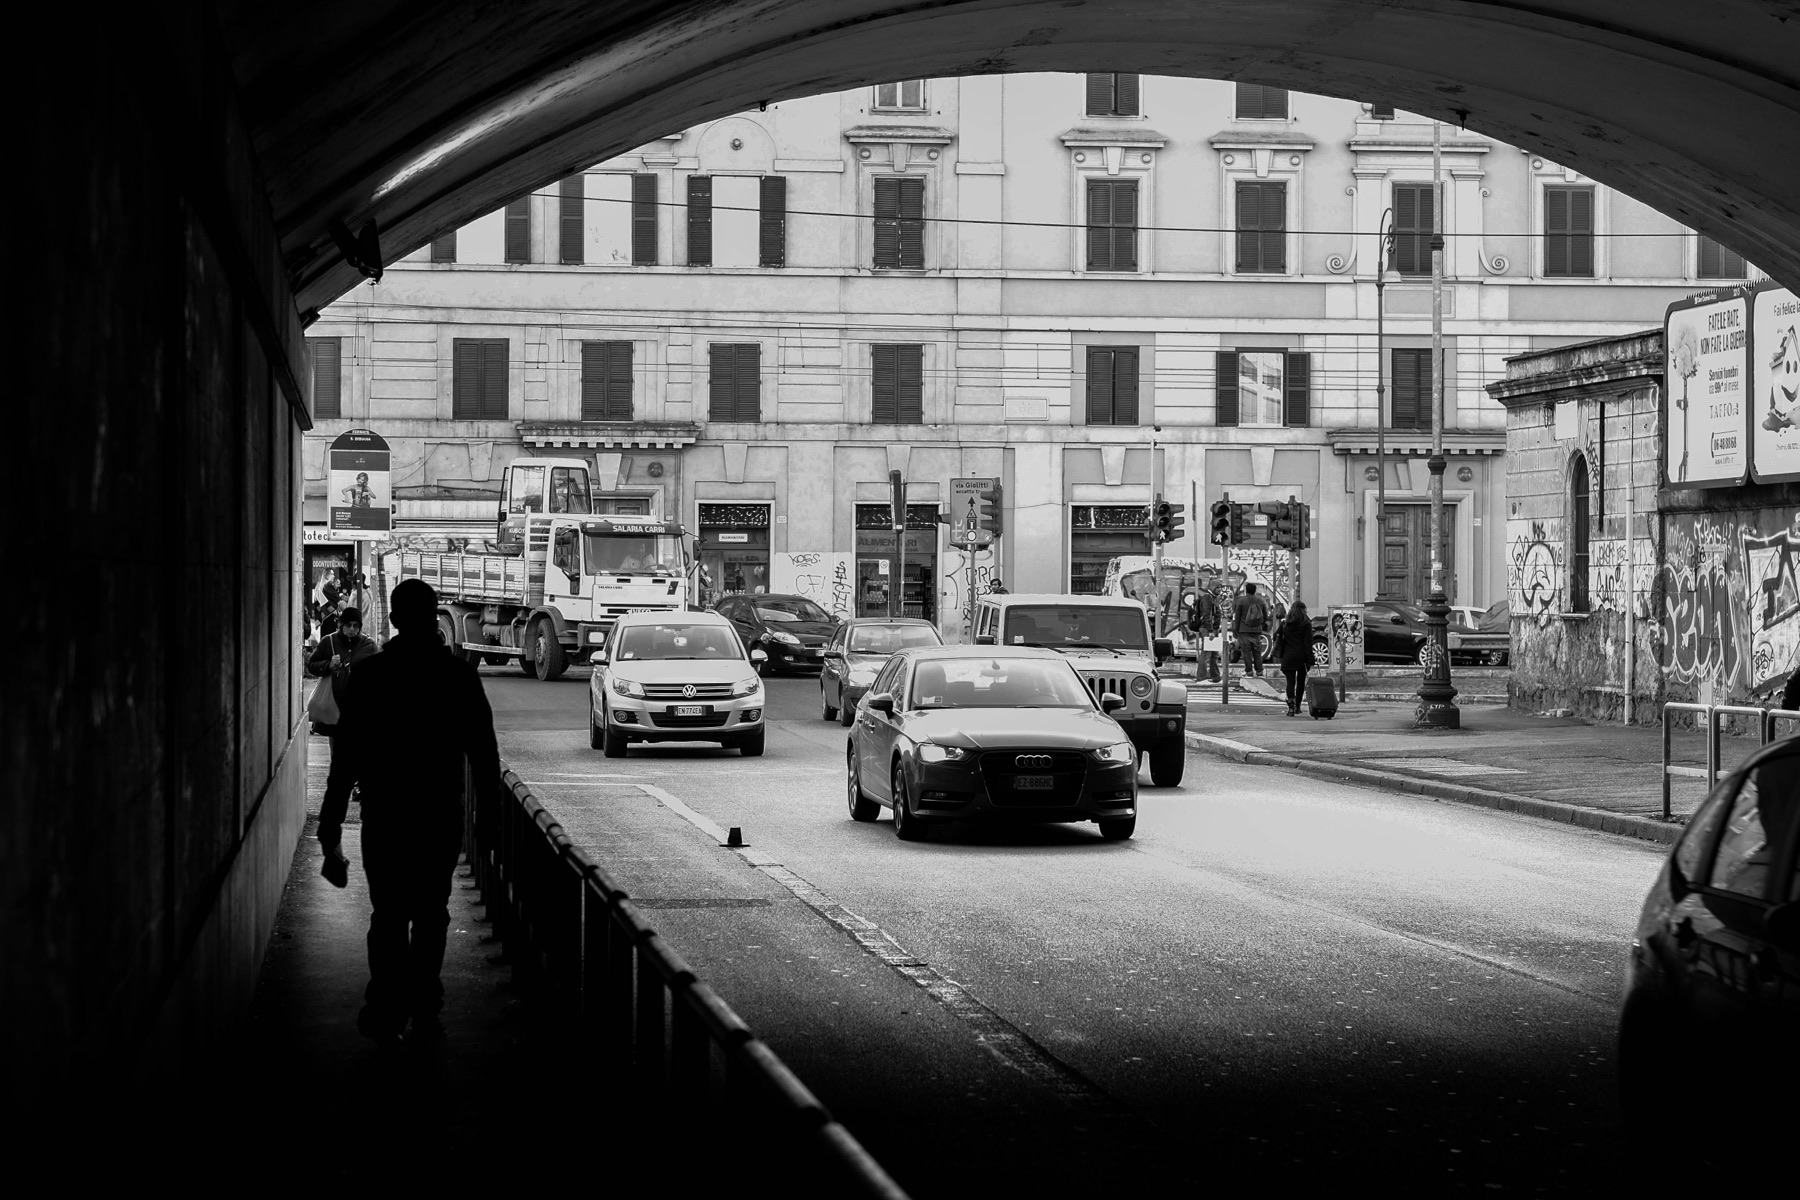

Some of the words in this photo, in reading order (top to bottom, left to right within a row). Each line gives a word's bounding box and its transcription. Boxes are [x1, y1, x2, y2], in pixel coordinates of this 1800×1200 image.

[1782, 302, 1796, 315] felice
[1708, 312, 1720, 332] FATE
[1720, 312, 1726, 330] LE
[1711, 334, 1722, 354] FATE
[1723, 334, 1729, 352] LA
[1710, 402, 1732, 419] TAFFO
